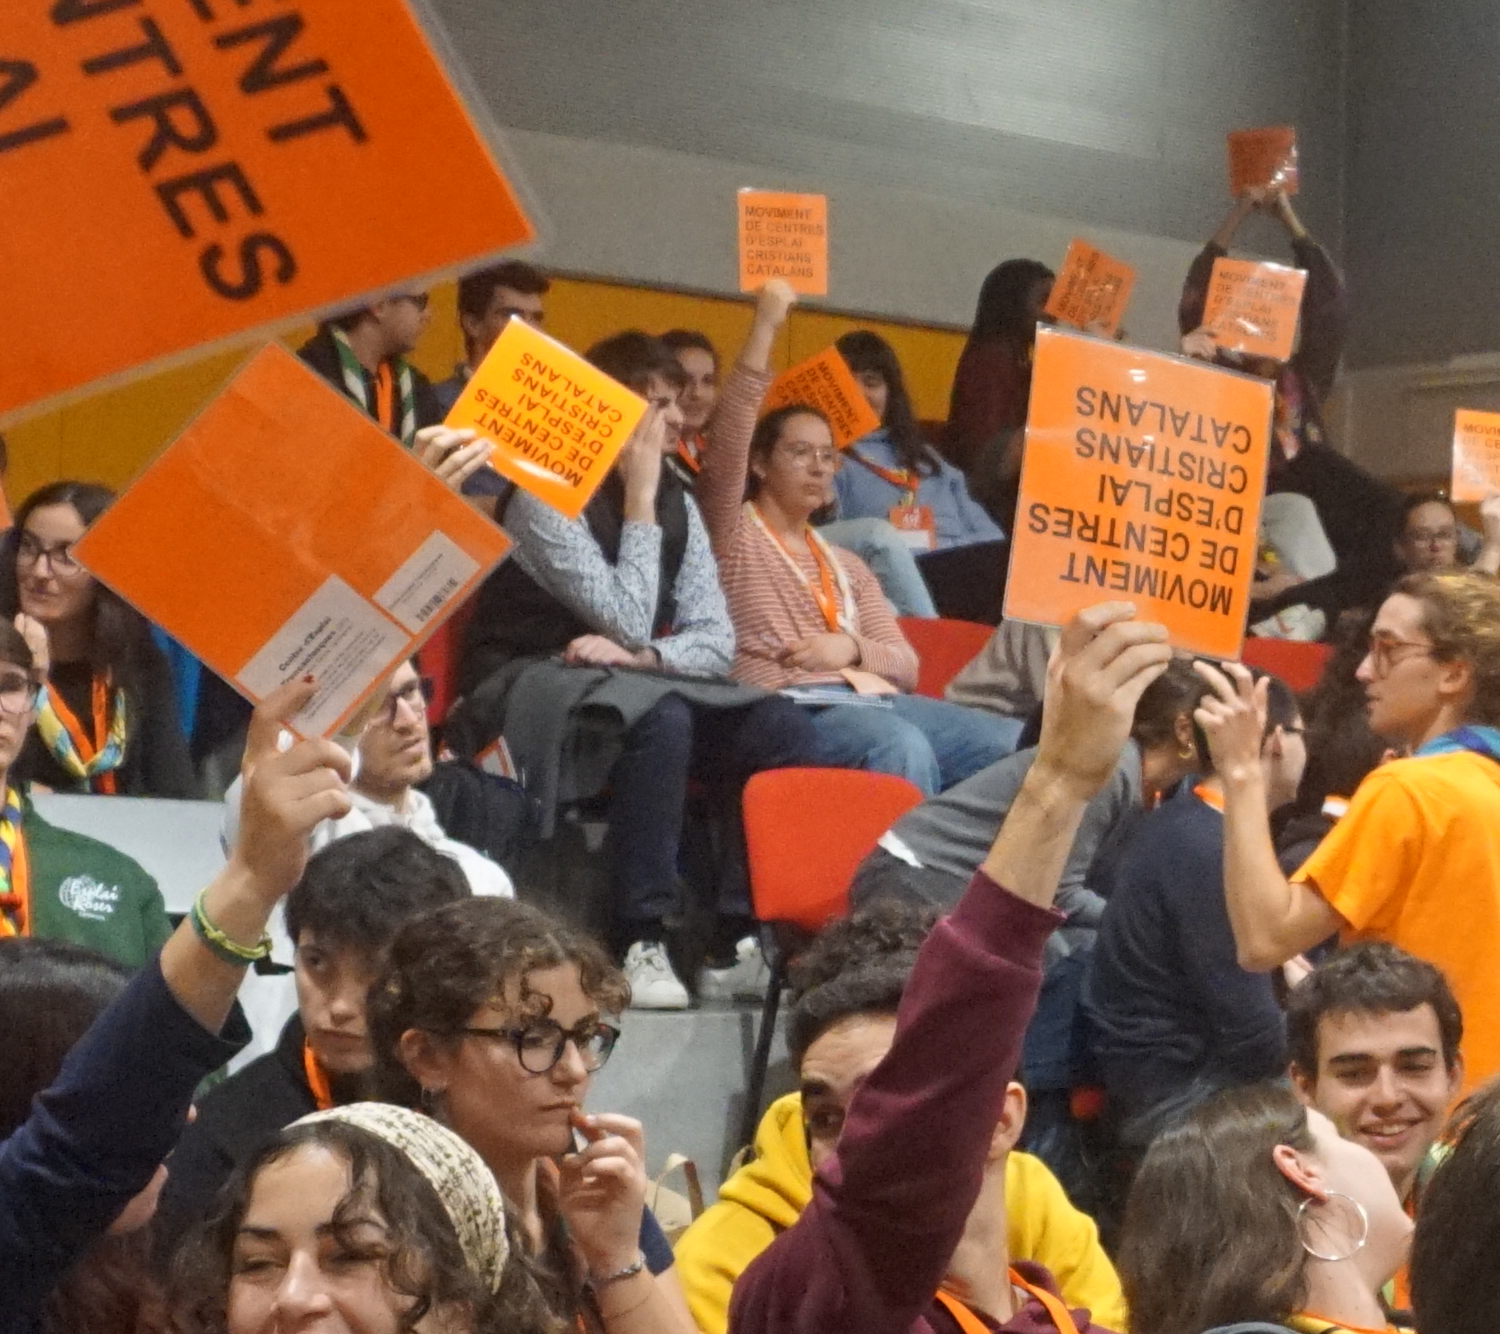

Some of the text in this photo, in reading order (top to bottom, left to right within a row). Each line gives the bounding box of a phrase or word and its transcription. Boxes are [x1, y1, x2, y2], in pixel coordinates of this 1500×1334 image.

[512, 368, 613, 438] CRISTIANS
[520, 352, 622, 423] CATALANS
[1076, 386, 1251, 455] CATALANS
[473, 413, 583, 488] MOVIMENT
[474, 388, 595, 472] DE CENTRES
[1075, 427, 1248, 495] CRISTIANS
[1028, 503, 1239, 575] DE CENTRES
[1059, 552, 1233, 616] MOVIMENT
